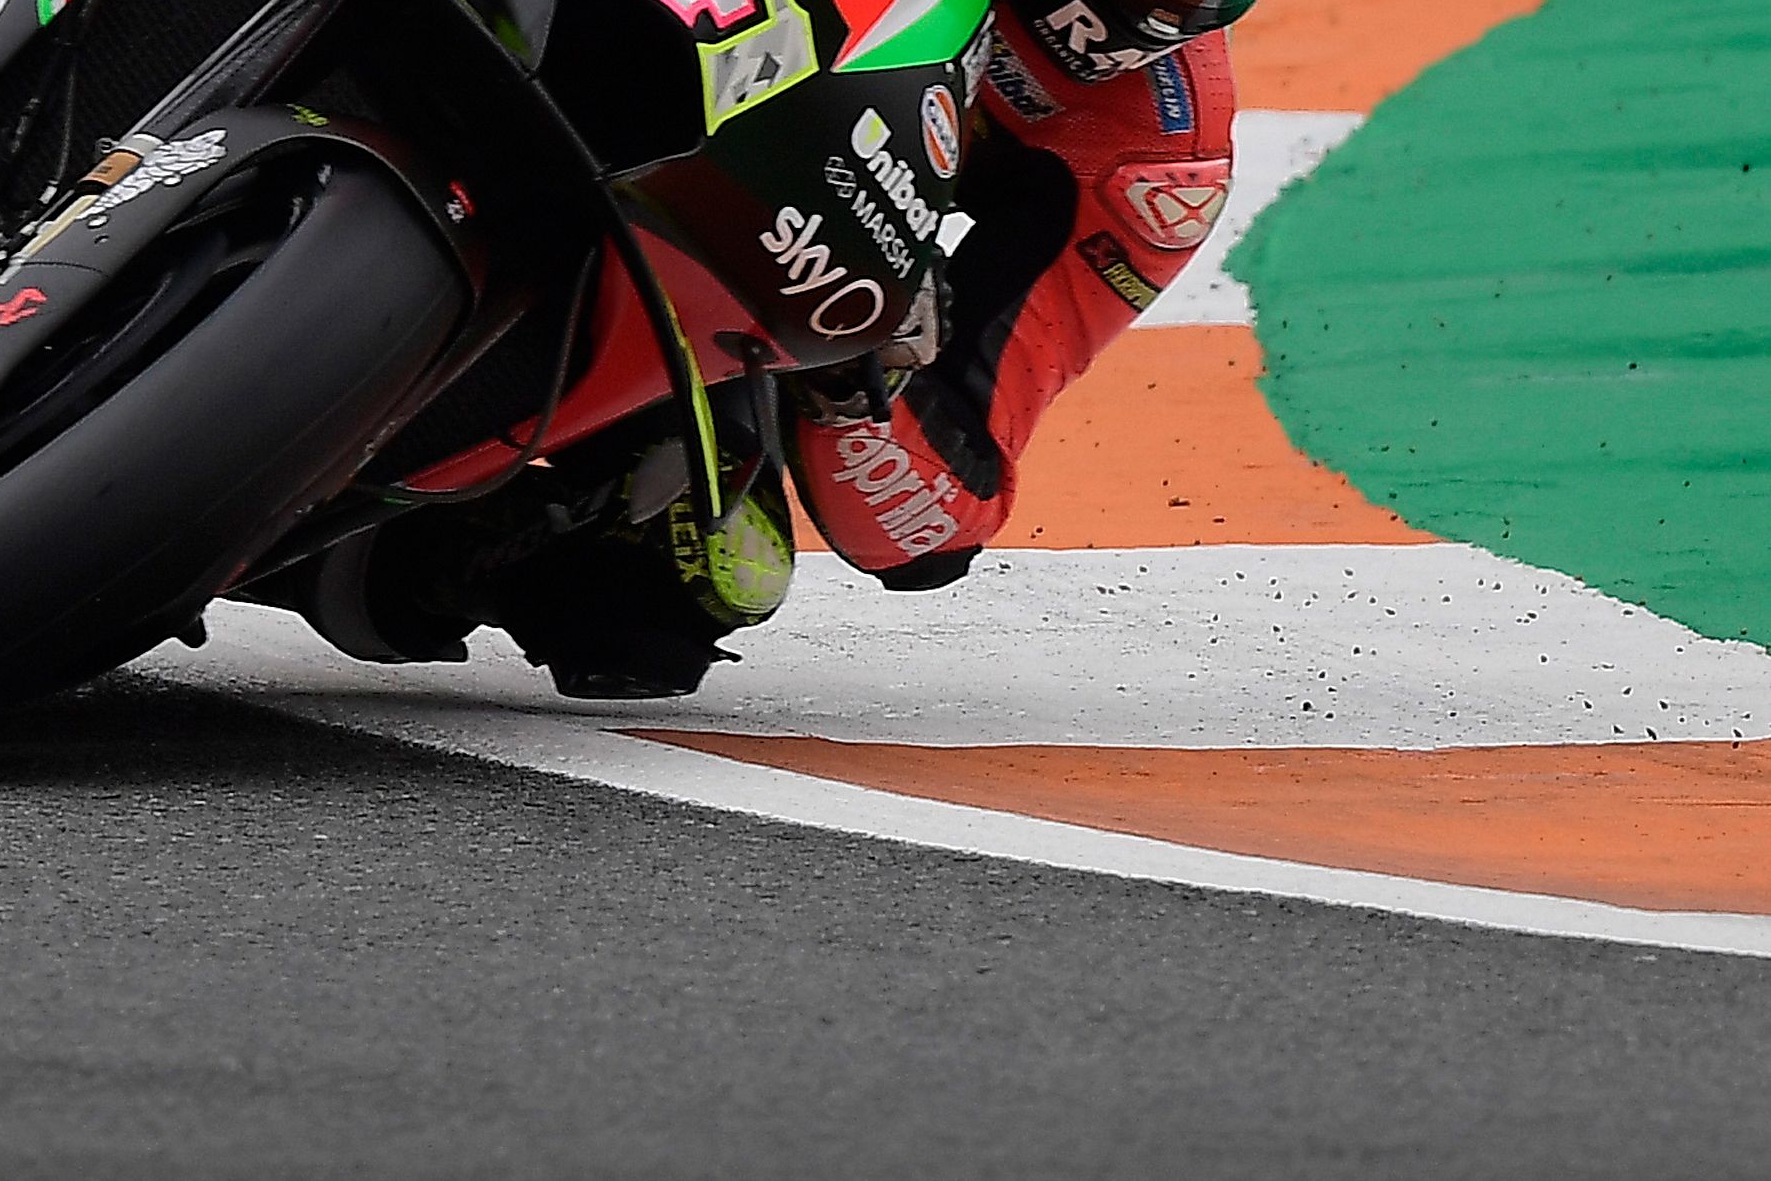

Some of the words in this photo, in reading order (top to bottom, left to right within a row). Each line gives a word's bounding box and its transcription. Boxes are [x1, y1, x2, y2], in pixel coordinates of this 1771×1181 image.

[850, 107, 942, 242] Unibat
[850, 190, 917, 279] MARSH
[808, 278, 887, 343] Q
[832, 417, 961, 558] aprilia
